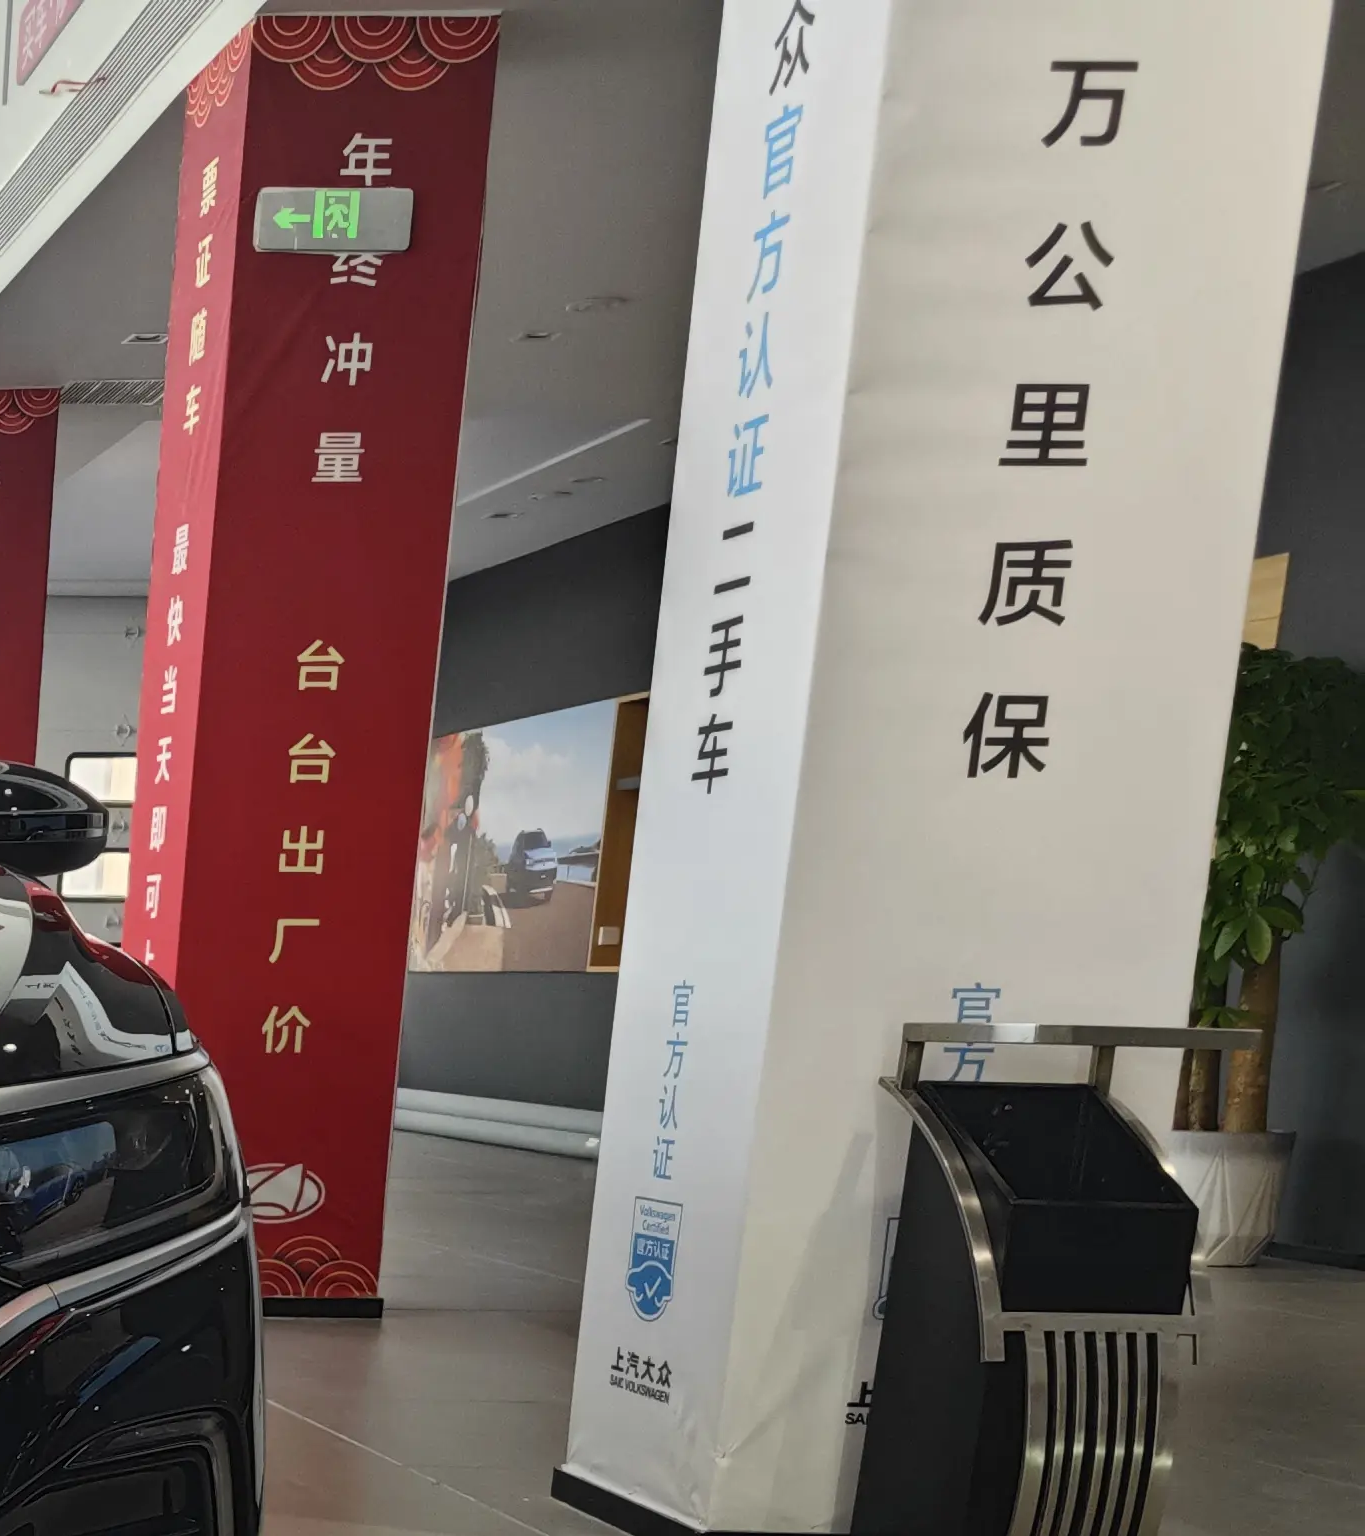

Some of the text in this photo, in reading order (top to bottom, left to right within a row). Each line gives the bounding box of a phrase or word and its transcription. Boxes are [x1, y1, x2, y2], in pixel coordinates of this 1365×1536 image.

[963, 60, 1139, 778] 万公里质保
[262, 639, 345, 1054] 台台出厂价
[653, 980, 695, 1181] 官方认证
[611, 1346, 672, 1388] 上汽大众
[625, 1379, 670, 1405] VOLKSWAGEN
